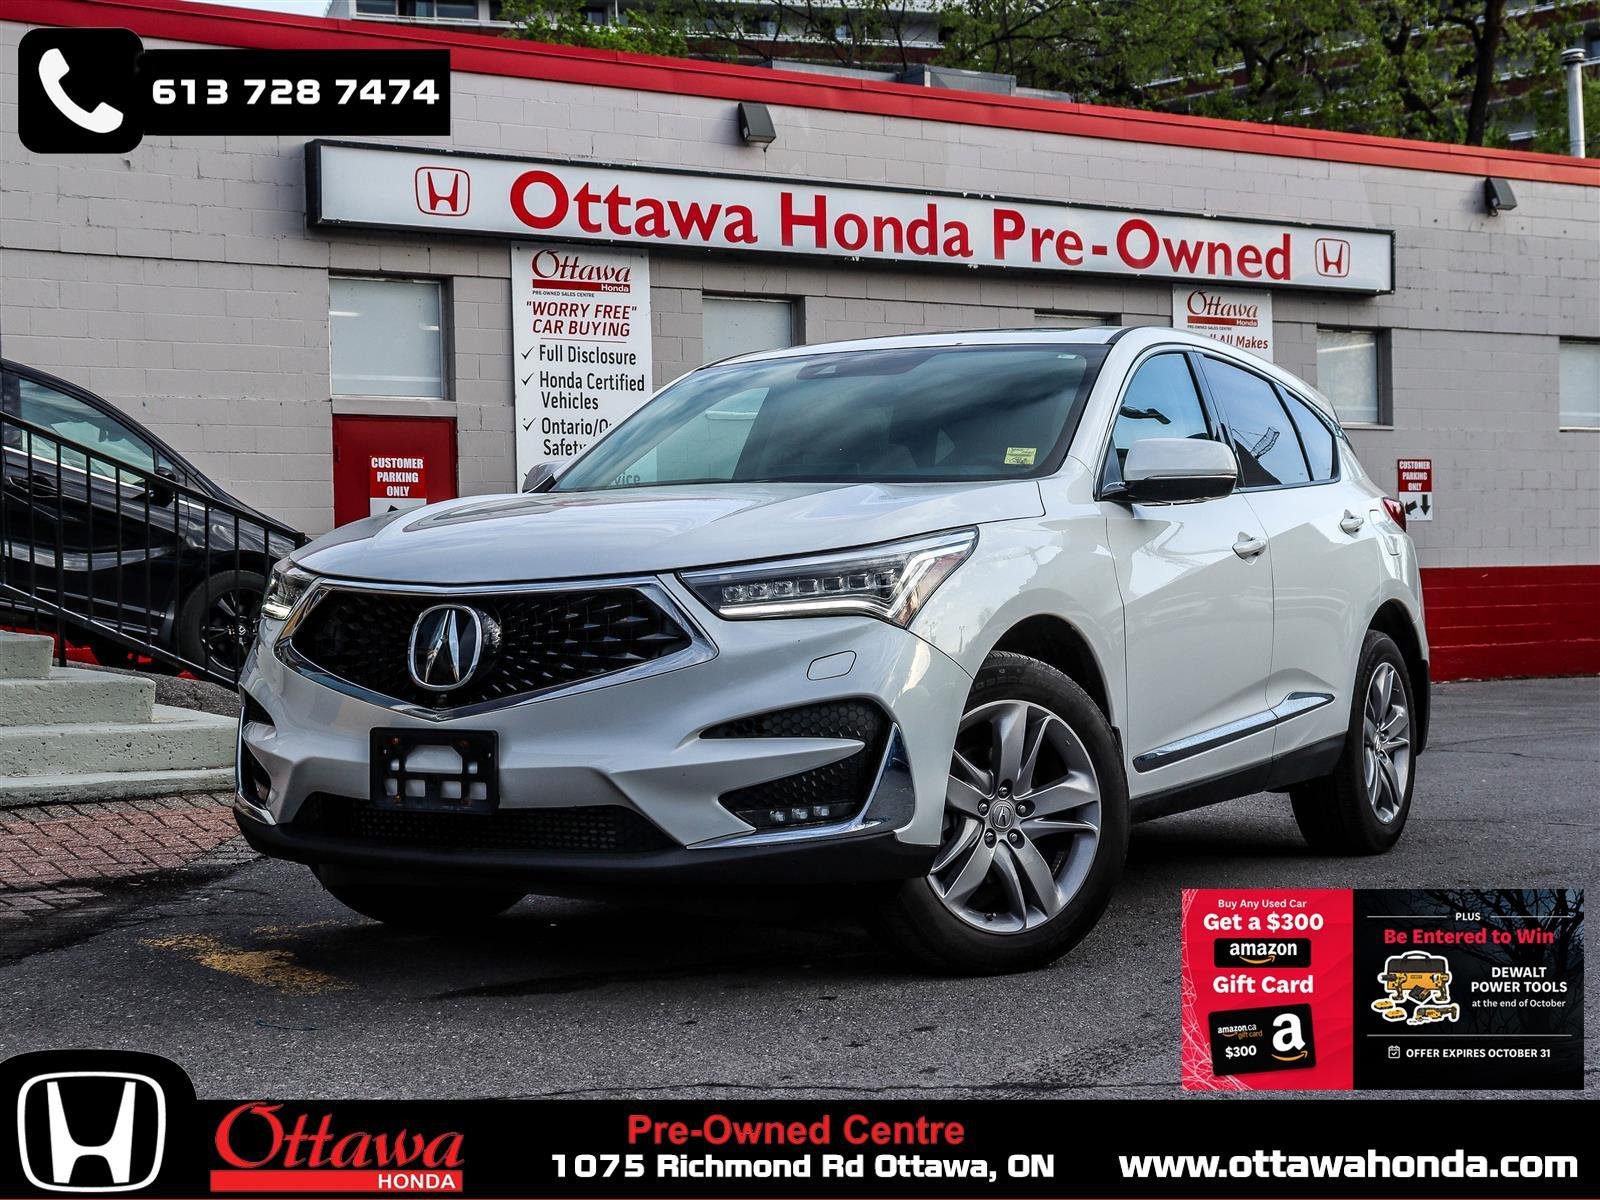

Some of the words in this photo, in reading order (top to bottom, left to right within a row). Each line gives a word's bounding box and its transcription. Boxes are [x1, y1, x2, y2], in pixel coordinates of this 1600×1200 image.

[509, 170, 758, 245] Ottawa
[780, 191, 973, 258] Honda
[993, 208, 1292, 281] Pre-Owned
[531, 249, 632, 282] Ottawa
[601, 283, 630, 294] Honda
[526, 301, 590, 318] "WORRY
[595, 305, 637, 320] FREE"
[1187, 289, 1258, 318] Ottawa
[532, 319, 564, 335] CAR
[568, 322, 631, 337] BUYING
[1236, 319, 1258, 327] Honda
[1235, 336, 1269, 350] Makes
[539, 344, 563, 362] Full
[568, 347, 637, 365] Disclosure
[539, 371, 583, 390] Honda
[586, 373, 645, 392] Certified
[541, 392, 599, 410] Vehicles
[371, 457, 424, 469] CUSTOMER
[1399, 461, 1431, 470] CUSTOMER
[376, 471, 419, 483] PARKING
[1402, 471, 1428, 480] PARKING
[386, 486, 410, 497] ONLY
[1408, 482, 1422, 491] ONLY
